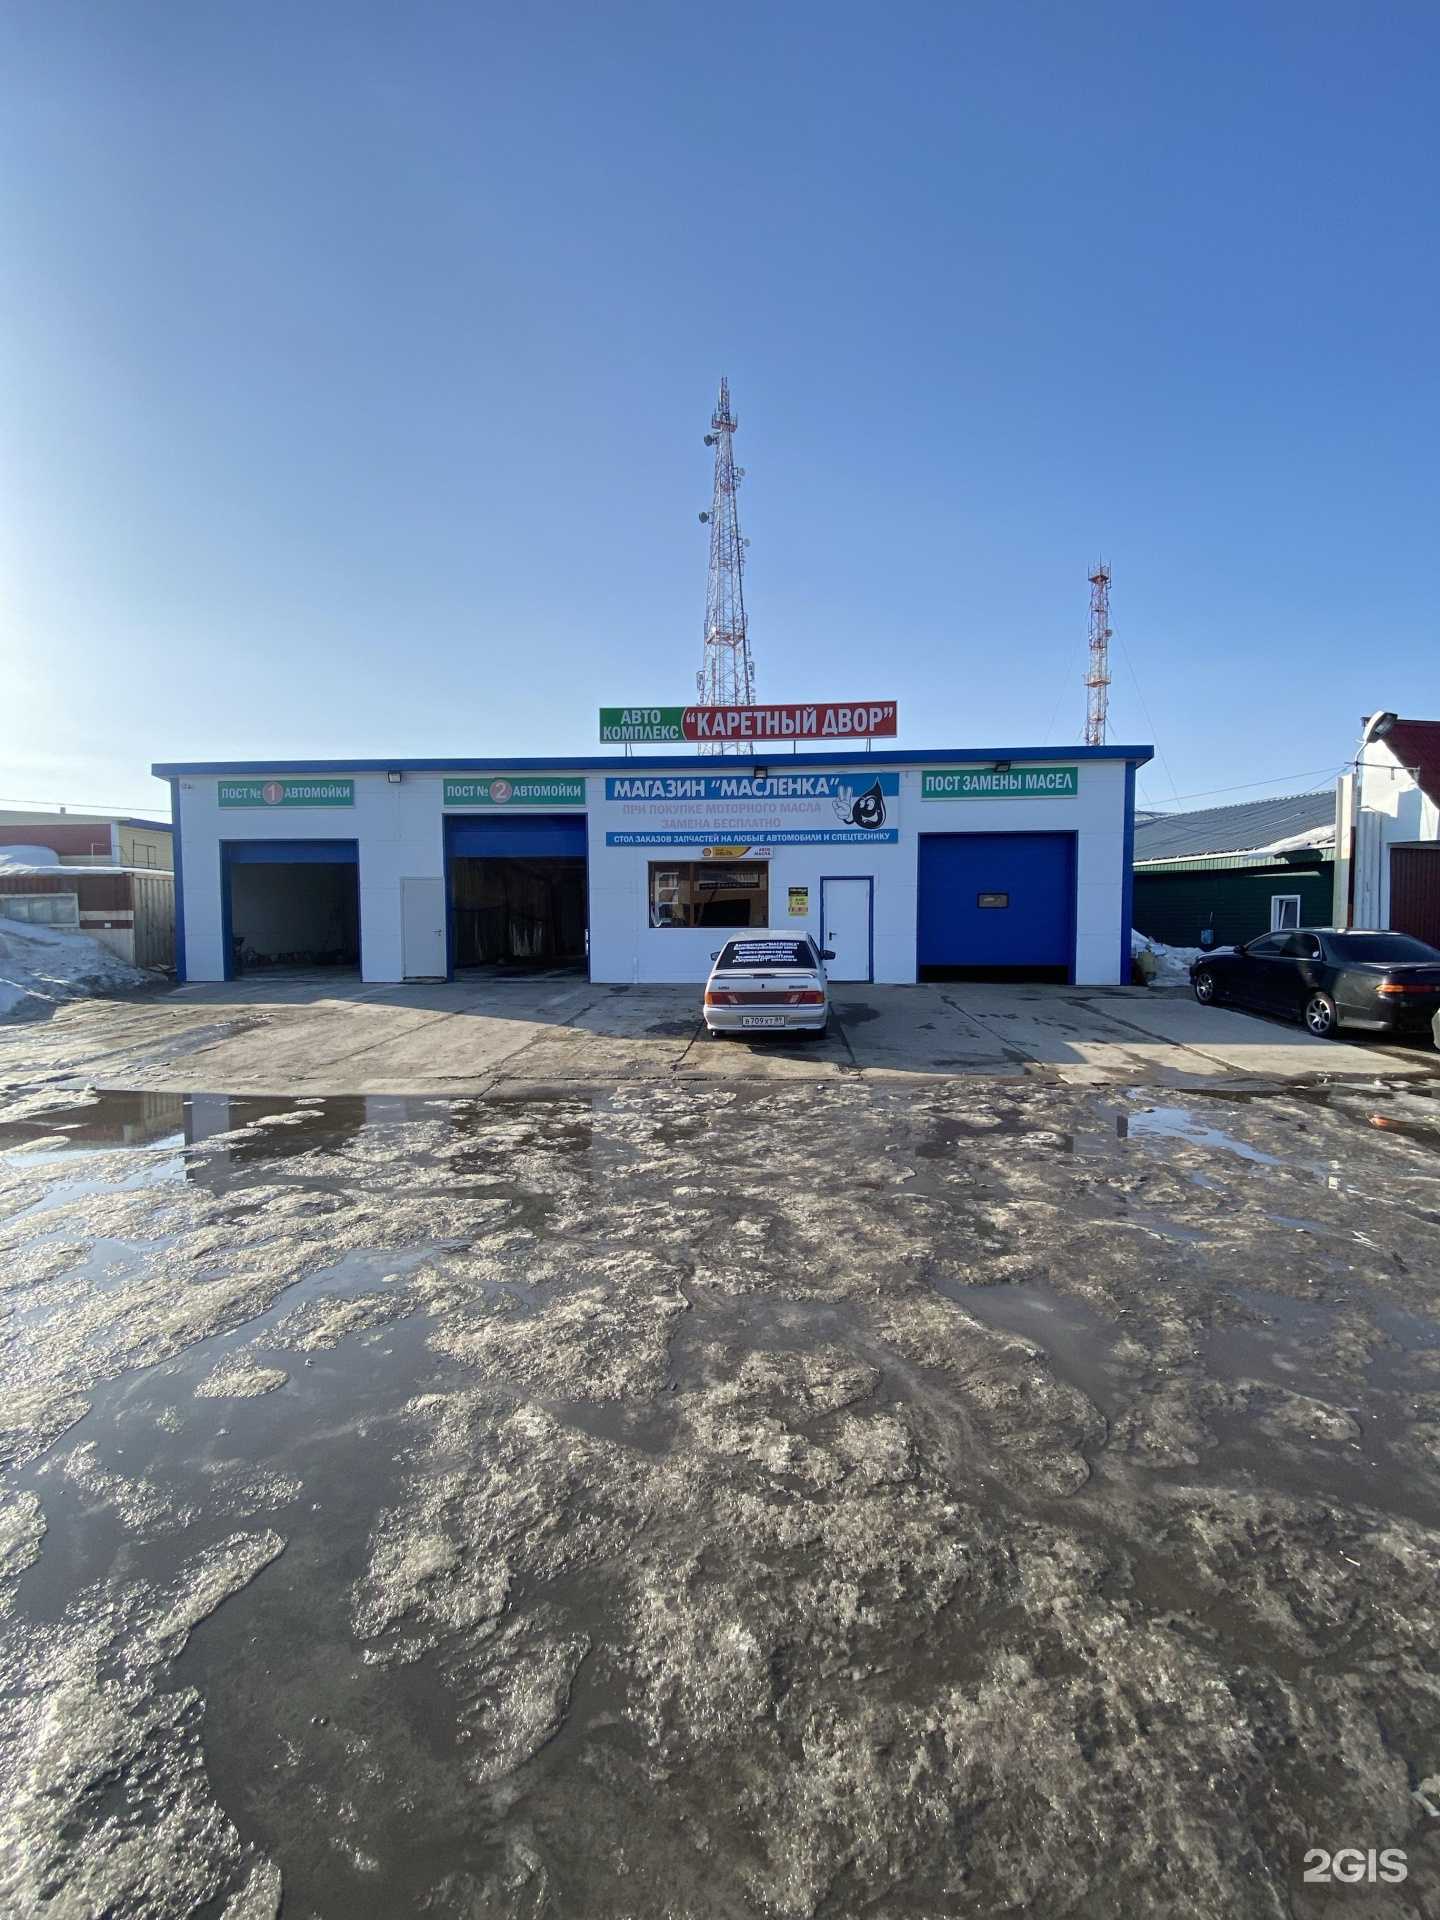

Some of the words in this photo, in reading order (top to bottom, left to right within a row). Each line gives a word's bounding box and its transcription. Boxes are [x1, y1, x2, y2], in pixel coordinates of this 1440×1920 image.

[620, 709, 661, 725] АВТО
[603, 725, 679, 740] КОМПЛЕКС
[614, 780, 705, 798] МАГАЗИН
[925, 775, 960, 791] ПОСТ
[963, 774, 1022, 790] ЗАМЕНЫ
[1025, 773, 1073, 789] МАСЕЛ
[222, 787, 249, 799] ПОСТ
[250, 788, 261, 798] №
[267, 784, 276, 801] 1
[284, 784, 350, 798] АВТОМОЙКИ
[447, 785, 474, 797] ПОСТ
[476, 785, 488, 797] №
[495, 782, 506, 799] 2
[513, 783, 581, 797] АВТОМОЙКИ
[623, 804, 647, 815] ПРИ
[651, 804, 702, 815] ПОКУПКЕ
[706, 802, 777, 814] МОТОРНОГО
[780, 802, 822, 812] МАСЛА
[661, 818, 710, 830] ЗАМЕНА
[714, 817, 782, 829] БЕСПЛАТНО
[614, 836, 634, 847] СТОЛ
[635, 835, 672, 847] ЗАКАЗОВ
[673, 833, 720, 847] ЗАПЧАСТЕЙ
[721, 834, 733, 845] НА
[733, 834, 765, 845] ЛЮБЫЕ
[766, 833, 822, 844] АВТОМОБИЛИ
[823, 832, 830, 843] И
[831, 832, 890, 845] СПЕЦТЕХНИКУ
